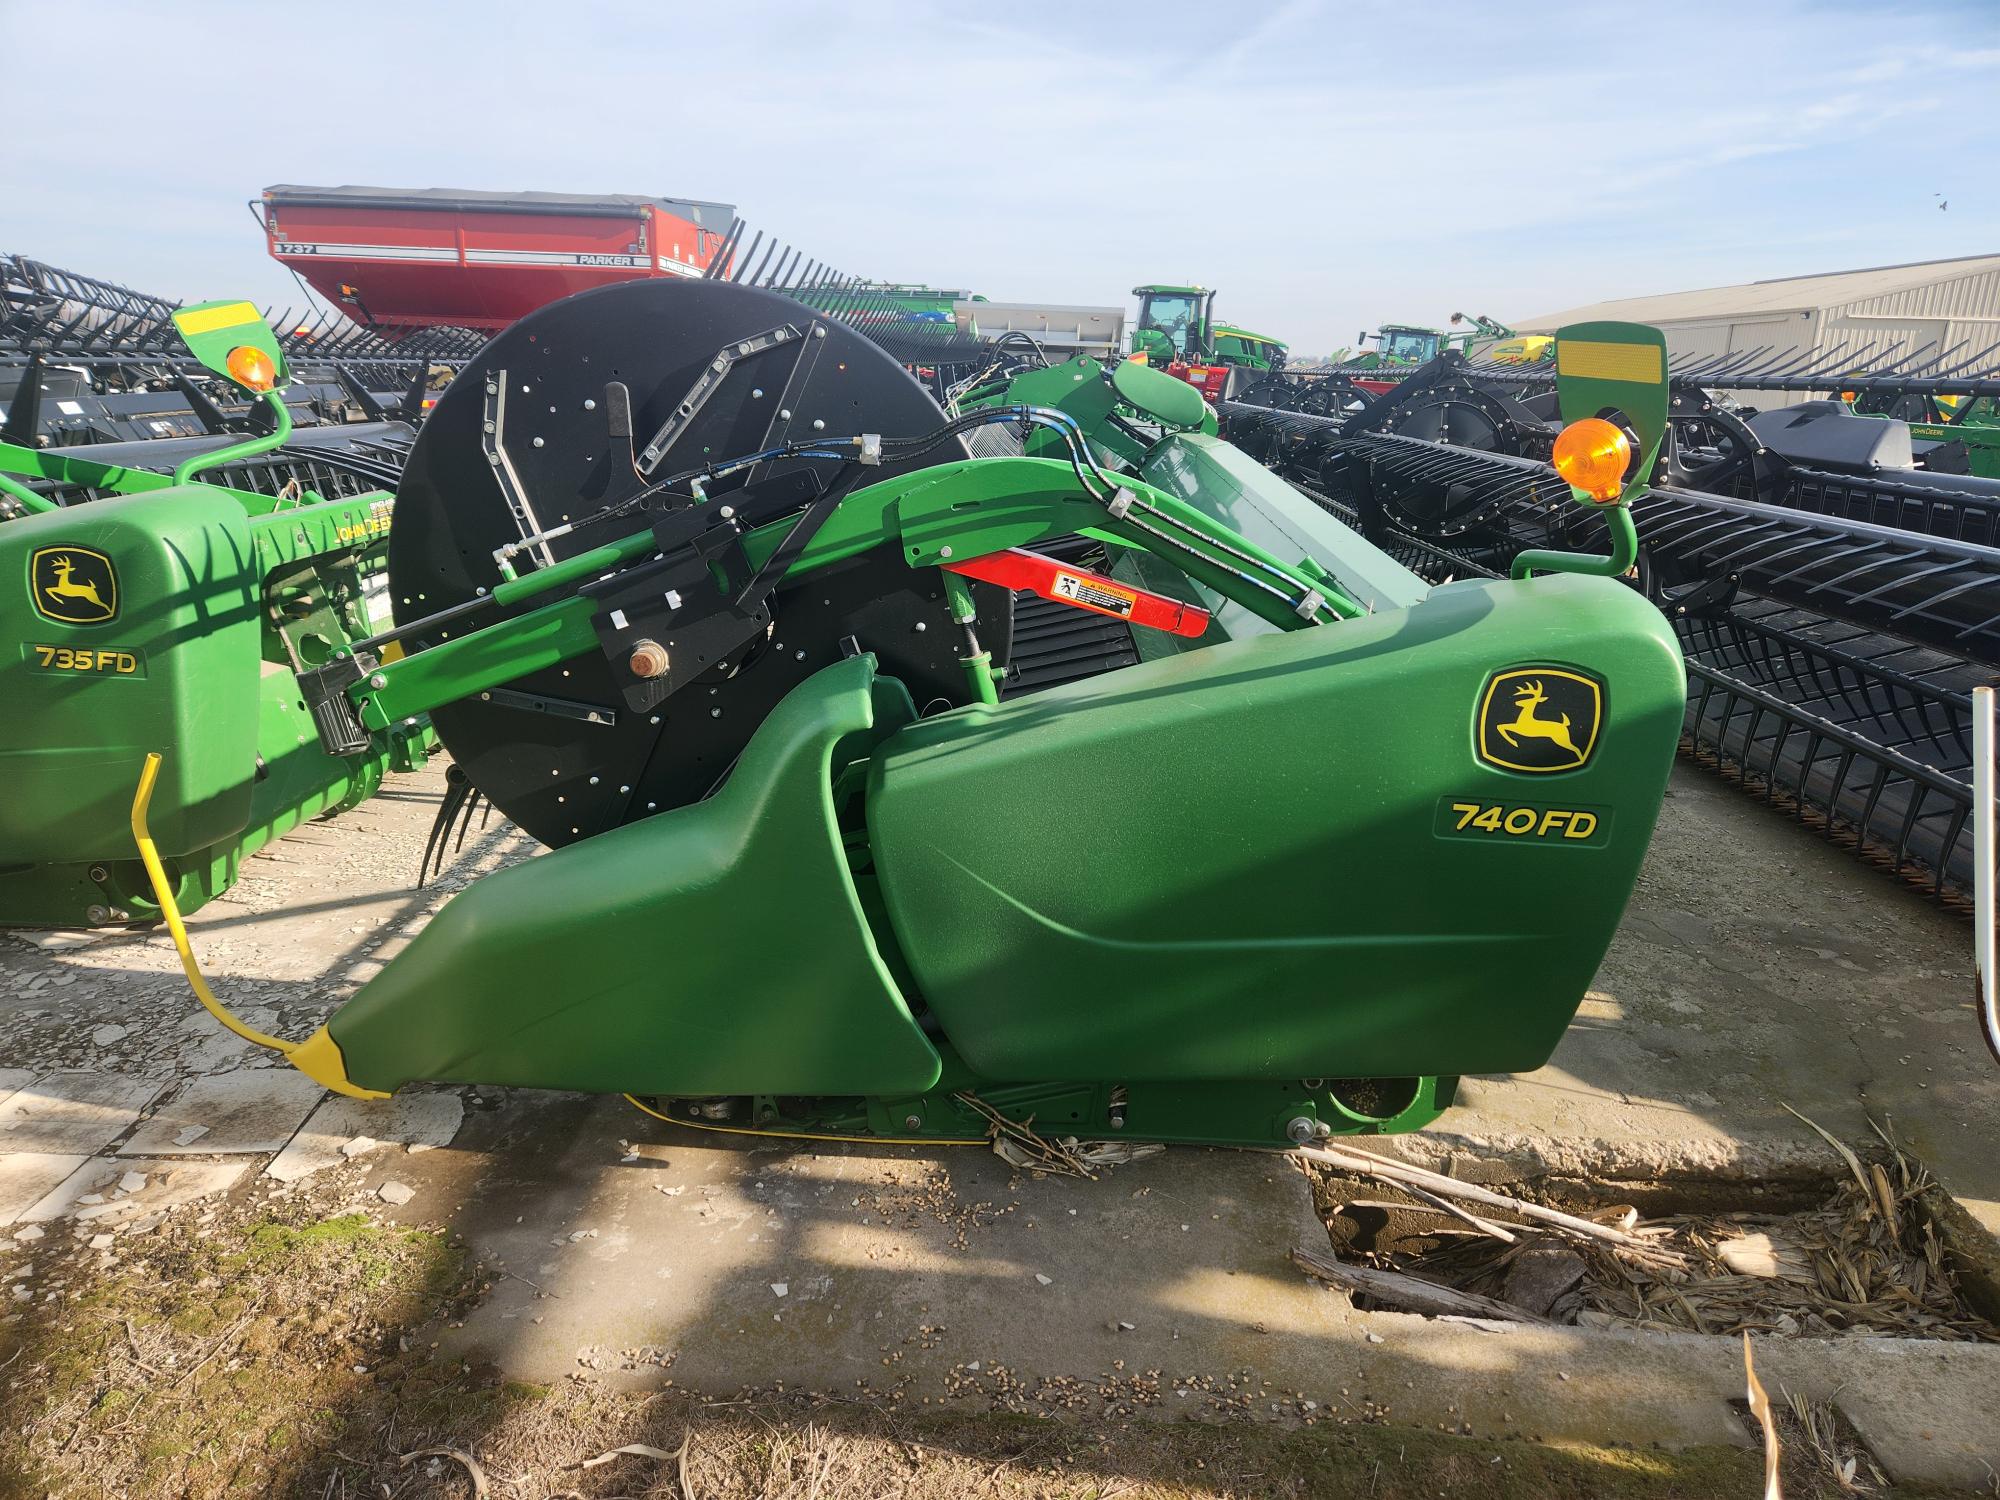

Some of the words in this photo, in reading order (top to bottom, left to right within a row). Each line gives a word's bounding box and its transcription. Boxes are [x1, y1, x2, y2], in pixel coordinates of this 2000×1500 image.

[283, 244, 313, 254] 737
[579, 255, 632, 266] PARKER
[334, 523, 366, 544] JOHN
[1098, 584, 1127, 599] WARNING
[35, 646, 137, 674] 735FD
[1452, 803, 1598, 840] 740FD
